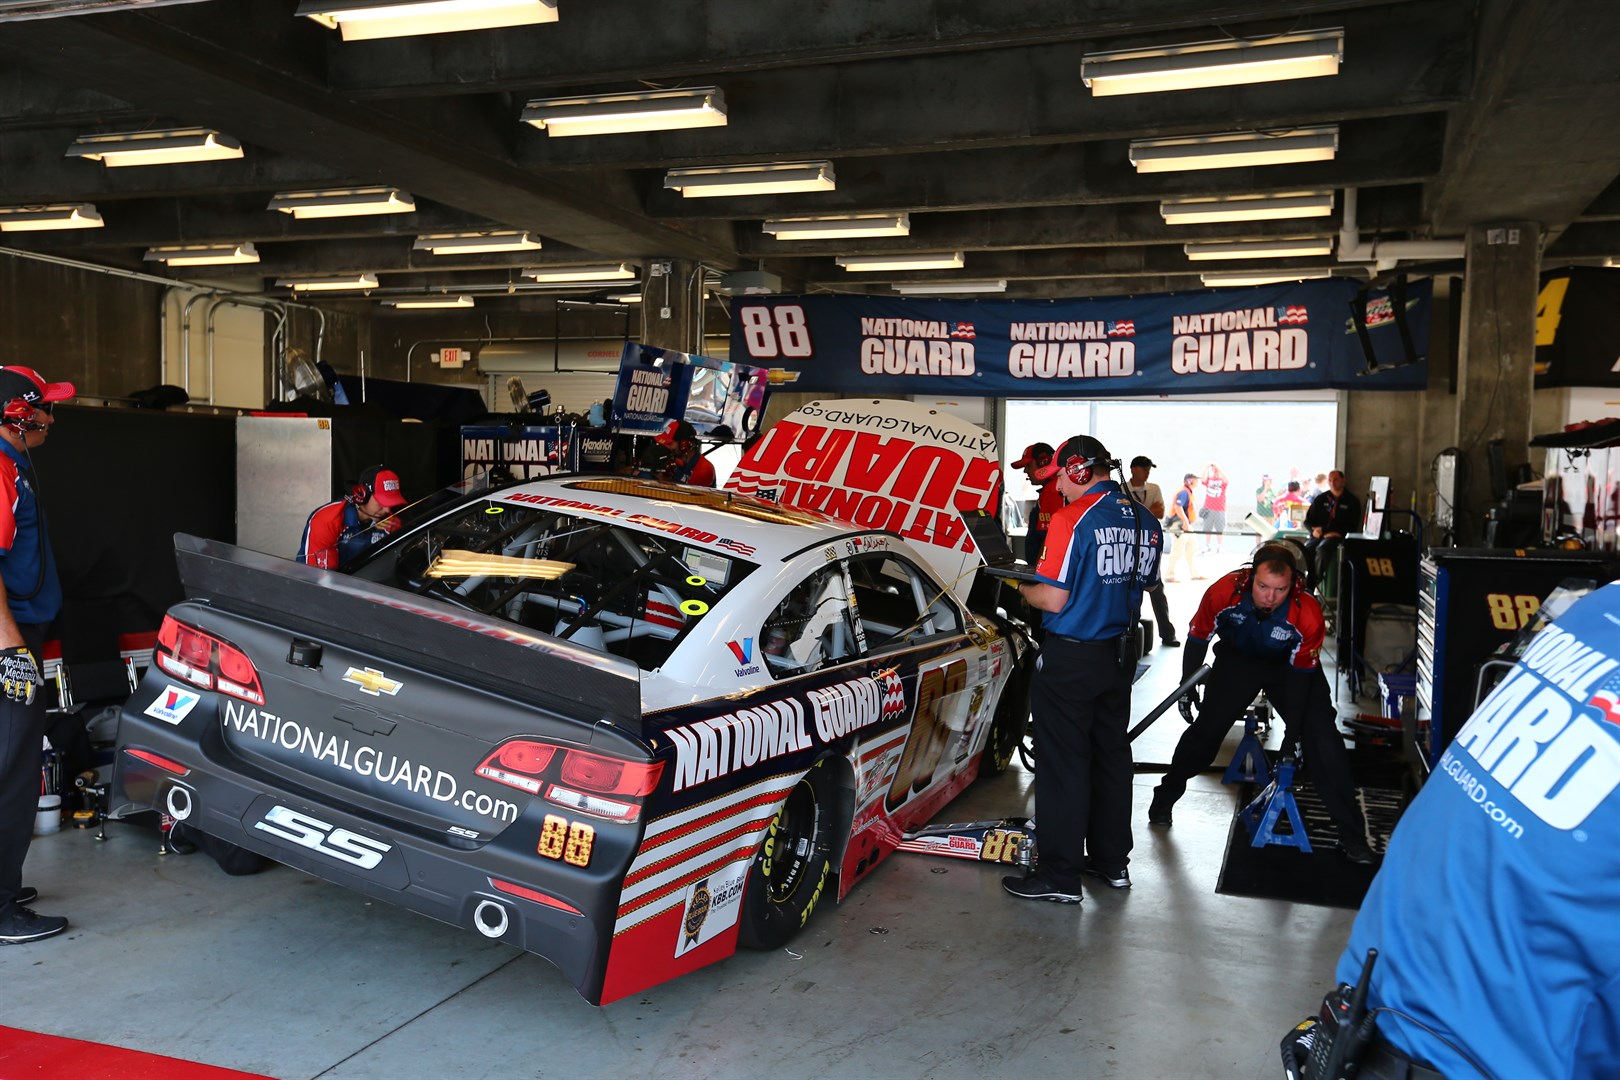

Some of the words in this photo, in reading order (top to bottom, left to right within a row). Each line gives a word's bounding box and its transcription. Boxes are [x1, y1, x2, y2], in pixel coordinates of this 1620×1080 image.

[740, 304, 814, 360] 88
[860, 317, 950, 339] NATIONAL
[1010, 320, 1108, 341] NATIONAL
[1171, 306, 1278, 336] NATIONAL
[444, 350, 458, 362] EXIT
[860, 338, 976, 377] GUARD
[1008, 341, 1136, 379] GUARD
[1171, 328, 1309, 376] GUARD
[631, 369, 664, 387] NATIONAL
[626, 384, 669, 414] GUARD
[582, 438, 613, 454] Hendrick
[503, 493, 625, 518] NATIONAL
[626, 514, 719, 543] GUARD
[1363, 557, 1396, 577] 88
[734, 665, 761, 678] Valvoline
[664, 696, 813, 793] NATIONAL
[807, 676, 881, 744] GUARD
[224, 699, 518, 824] NATIONALGUARD.com
[254, 805, 393, 870] SS
[446, 825, 480, 840] SS
[537, 813, 595, 868] 88
[949, 840, 976, 851] GUARD
[711, 881, 744, 908] KBB.COM
